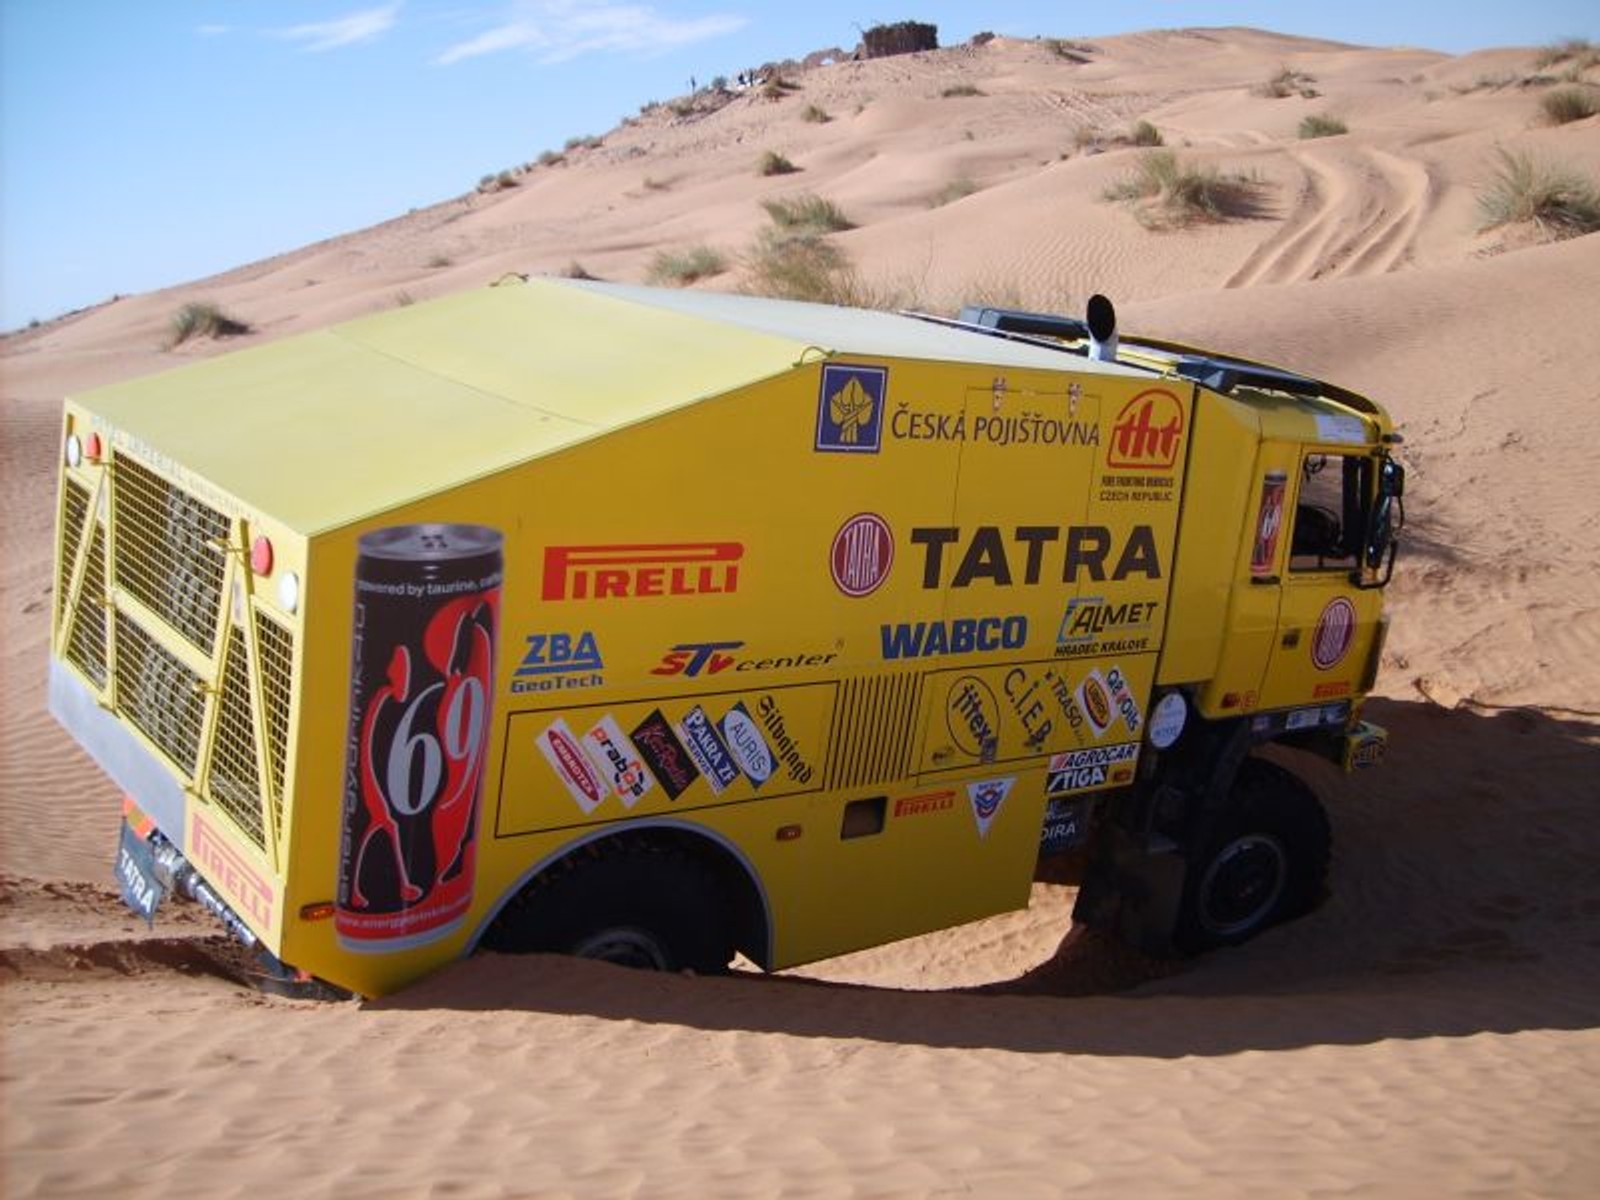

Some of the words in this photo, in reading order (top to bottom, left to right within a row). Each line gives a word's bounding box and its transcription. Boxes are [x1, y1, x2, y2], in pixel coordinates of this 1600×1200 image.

[891, 402, 967, 441] ČESKÁ
[973, 412, 1100, 446] POJIŠŤOVNA
[1100, 491, 1129, 501] CZECH
[1130, 491, 1173, 501] REPUBLIC
[541, 542, 745, 601] PIRELLI
[842, 521, 883, 589] TATRA
[910, 525, 1162, 589] TATRA
[407, 585, 424, 598] by
[520, 631, 603, 668] ZBA
[880, 615, 1028, 659] WABCO
[1055, 641, 1100, 657] HRADEC
[1052, 676, 1084, 728] TRASO
[387, 676, 485, 815] 69
[590, 726, 644, 797] prabos
[685, 707, 724, 766] PAKRA
[719, 761, 736, 780] ZF
[729, 721, 767, 772] AURIS
[756, 695, 812, 784] Silvajagd
[1064, 745, 1136, 769] AGROCAR
[894, 790, 956, 818] PIRELLI
[121, 848, 154, 913] TATRA
[191, 812, 274, 931] PIRELLI
